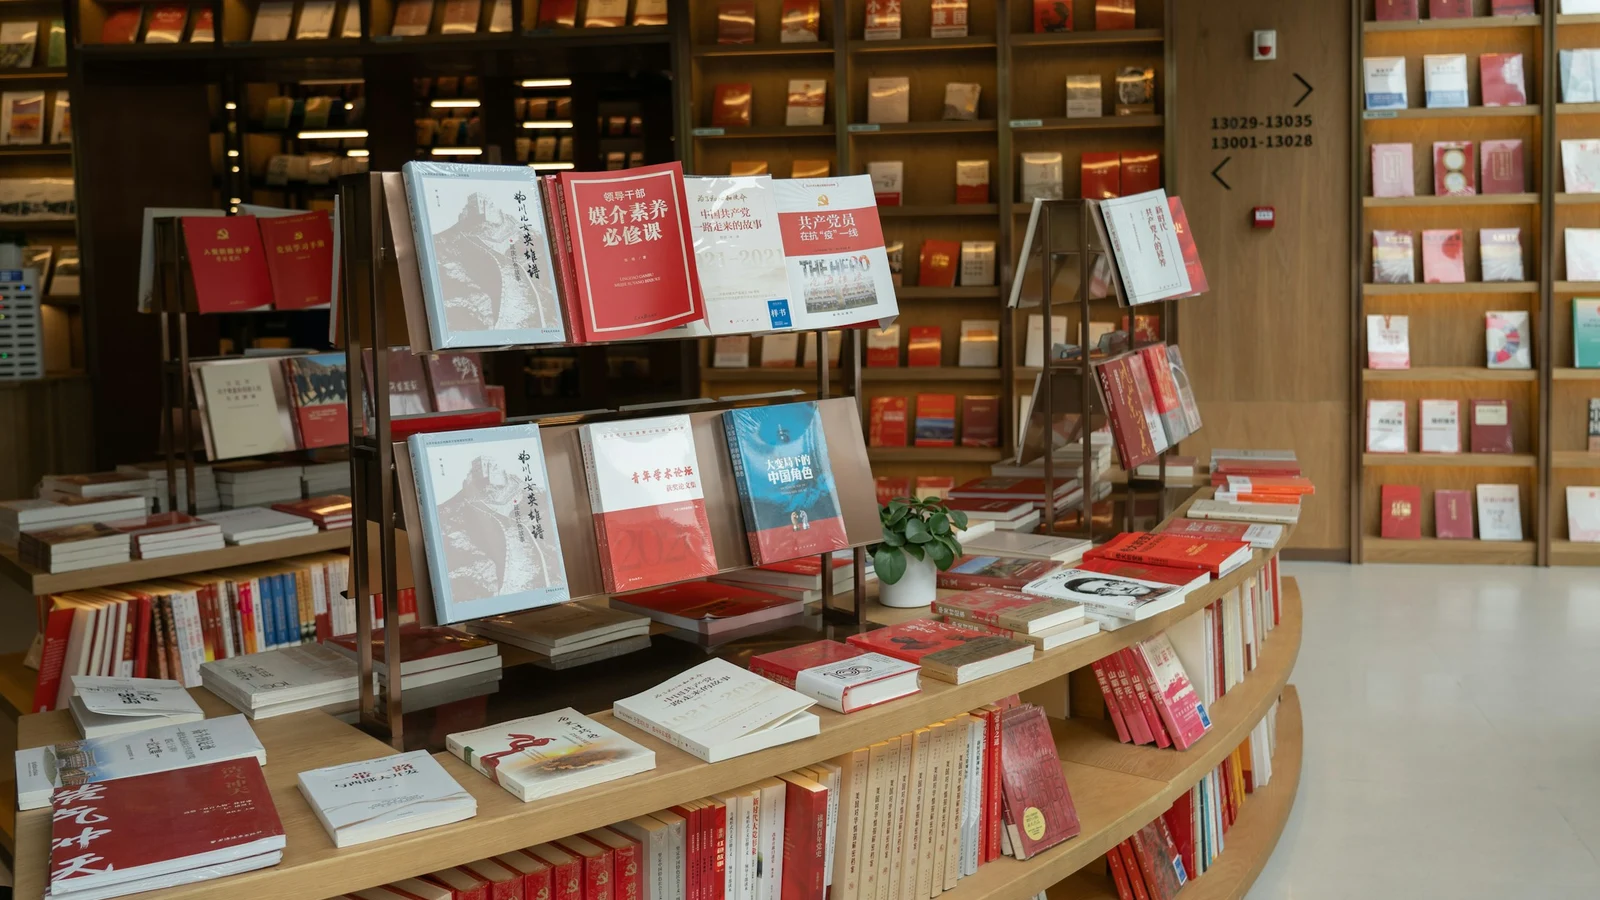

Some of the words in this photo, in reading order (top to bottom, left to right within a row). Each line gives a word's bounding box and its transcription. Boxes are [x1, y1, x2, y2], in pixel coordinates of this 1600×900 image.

[1211, 115, 1313, 130] 13029-13035
[1211, 134, 1313, 150] 13001-13028
[603, 188, 646, 202] 领导干部
[588, 199, 668, 226] 媒介素养
[700, 207, 751, 220] 中国共产党
[693, 219, 762, 232] 一路走来的故事
[798, 213, 856, 231] 共产党员
[602, 222, 663, 247] 必修课
[800, 228, 859, 241] 在抗“疫”一线
[799, 259, 828, 278] THE
[767, 454, 811, 471] 大变局下的
[631, 466, 694, 484] 青年学术论坛
[767, 466, 814, 485] 中国角色
[334, 769, 419, 790] 与西部大开发
